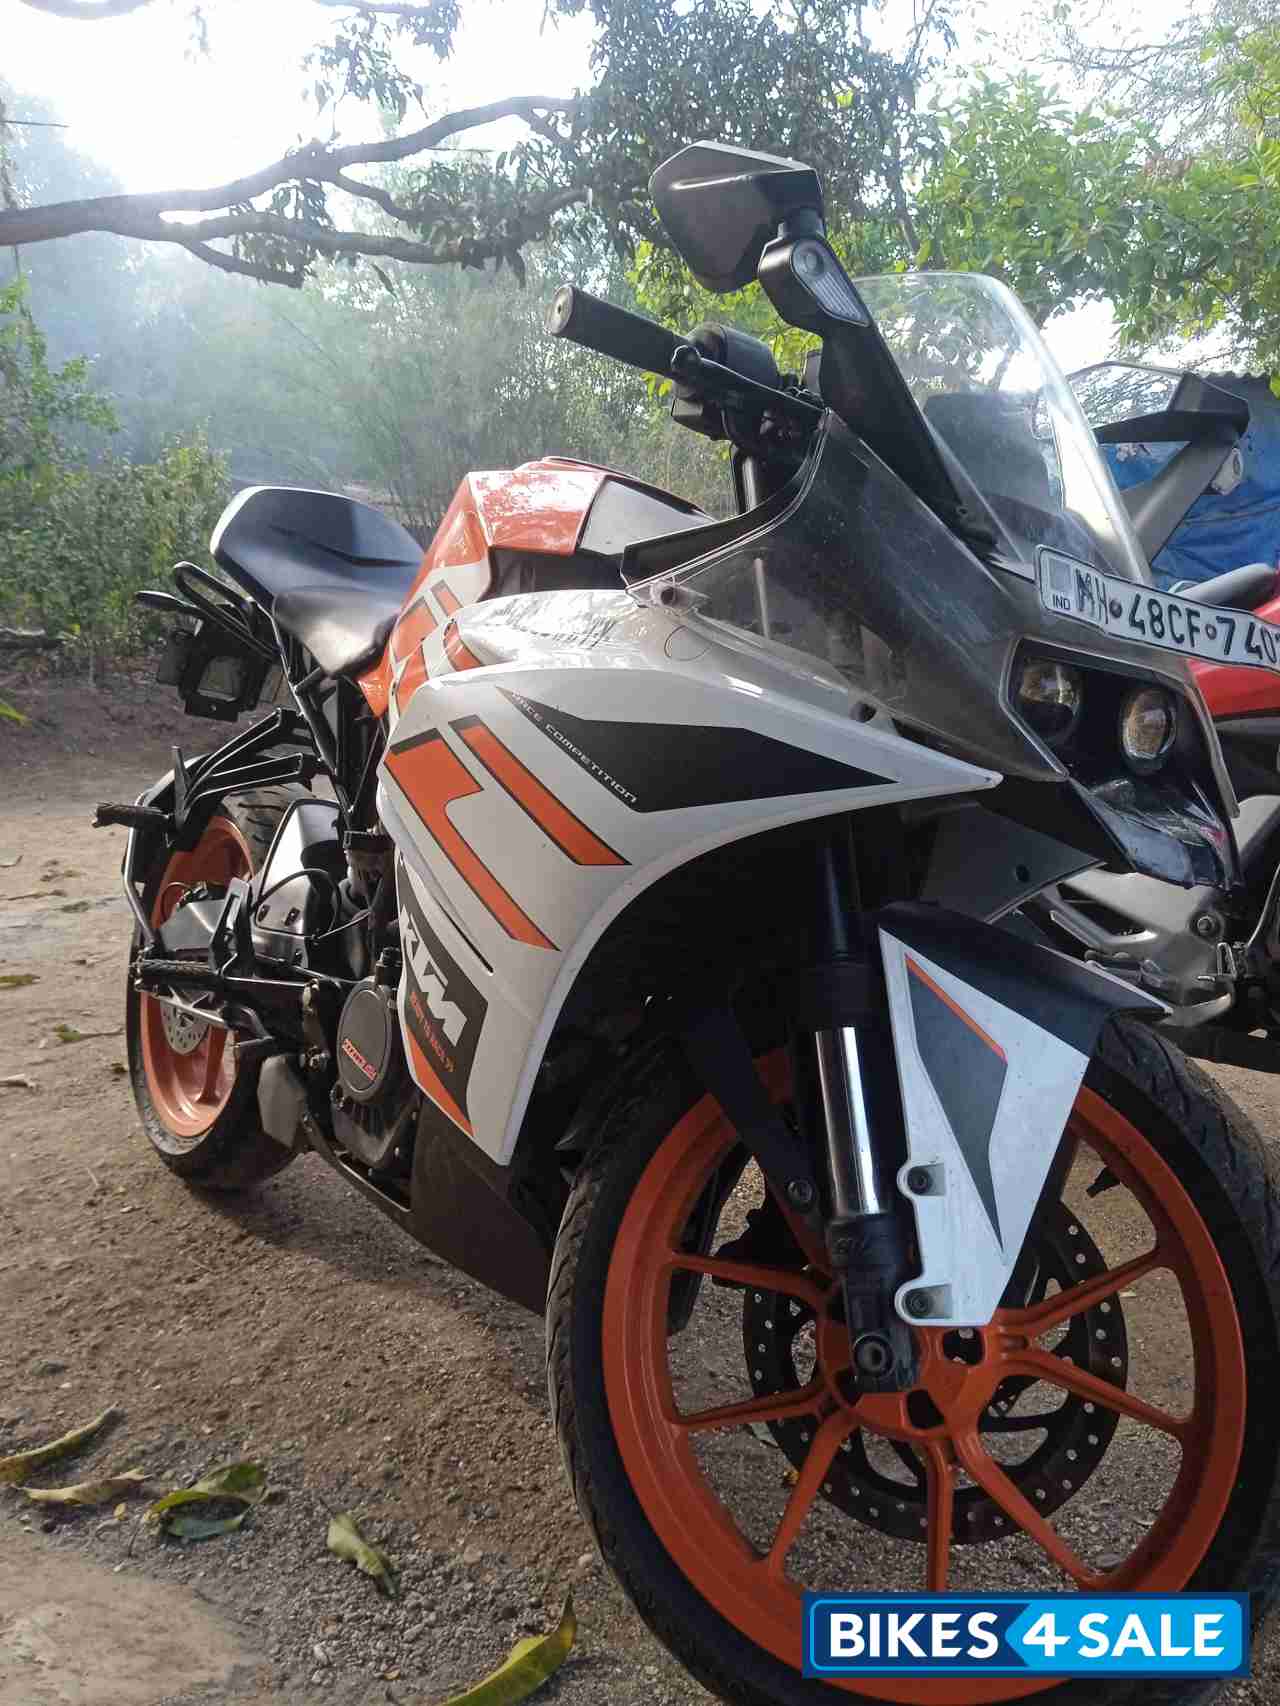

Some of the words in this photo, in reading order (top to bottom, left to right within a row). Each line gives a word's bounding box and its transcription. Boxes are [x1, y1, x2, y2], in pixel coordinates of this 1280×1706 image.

[1053, 594, 1070, 610] IND
[1128, 593, 1201, 648] 48CF
[1215, 615, 1280, 665] 740
[399, 903, 468, 1047] KTM
